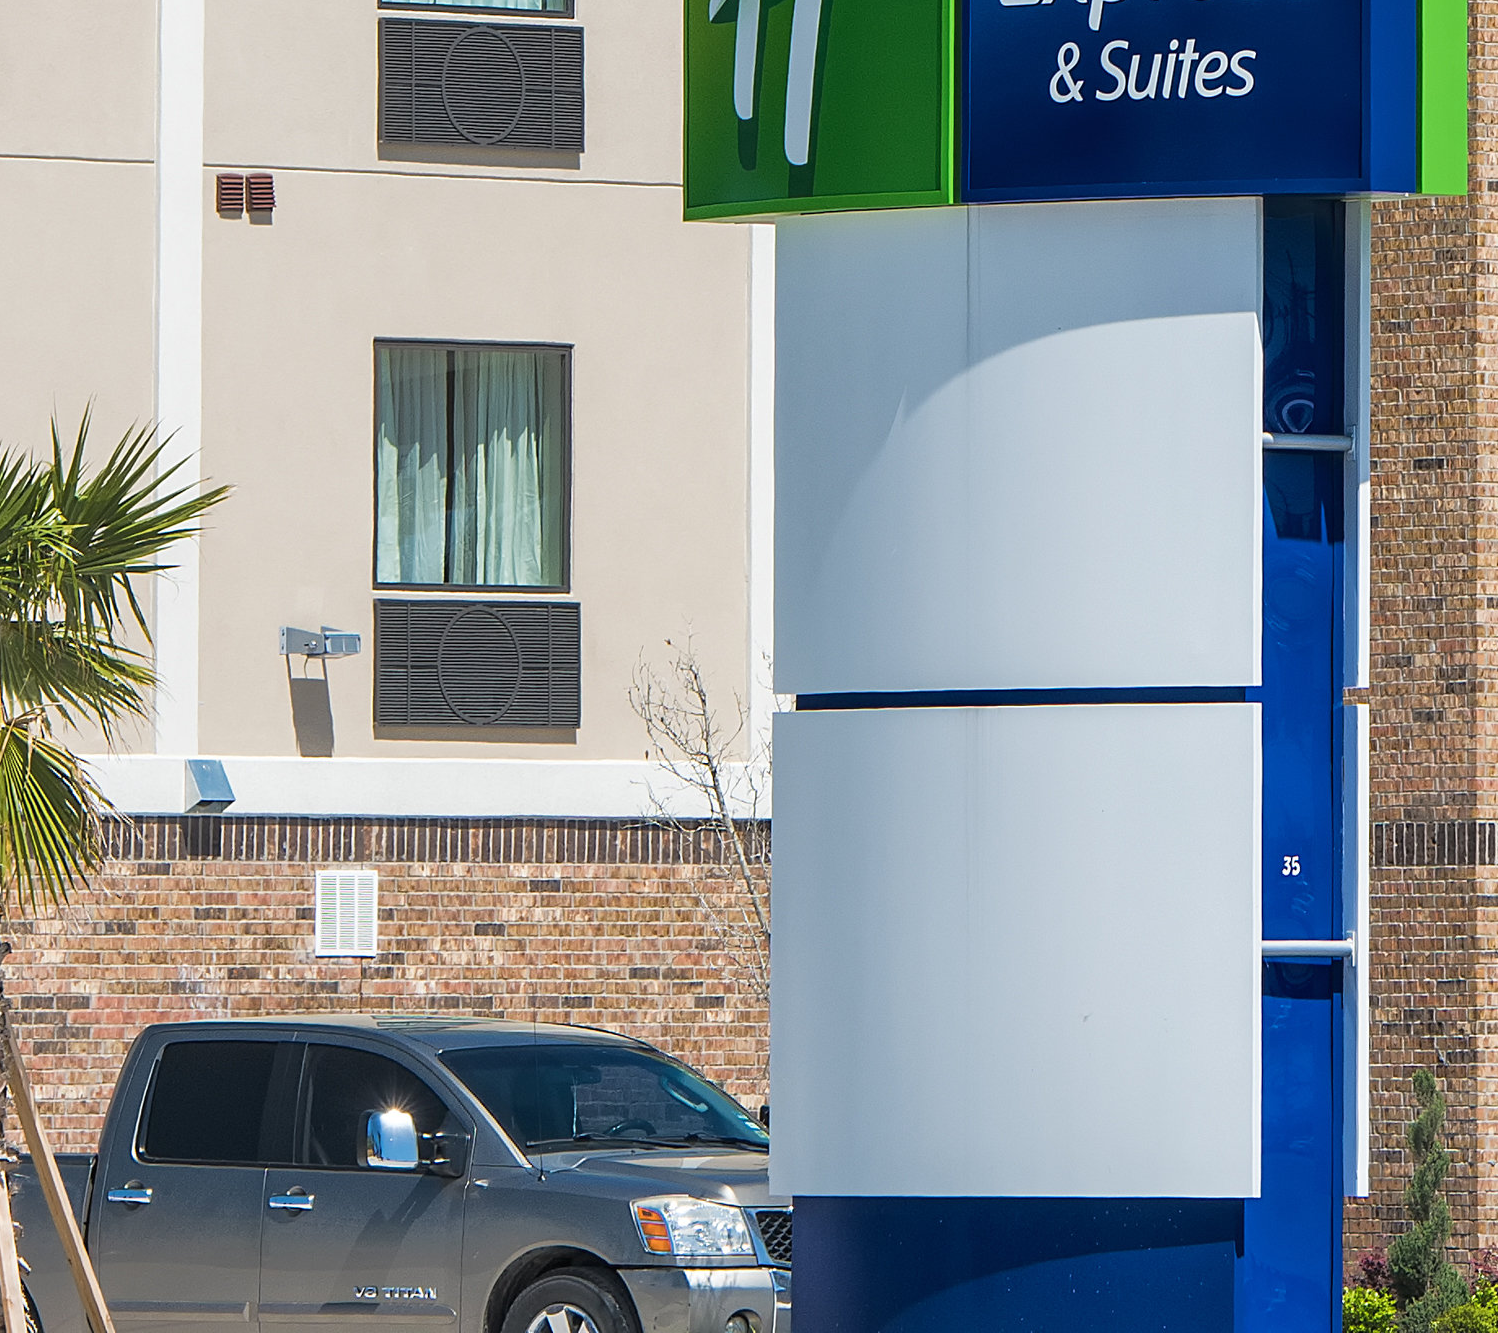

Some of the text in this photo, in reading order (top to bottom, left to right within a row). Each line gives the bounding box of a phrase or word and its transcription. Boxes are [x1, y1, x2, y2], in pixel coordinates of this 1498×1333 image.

[1048, 37, 1258, 105] & Suites
[1282, 855, 1301, 876] 35
[382, 1286, 438, 1300] TITAN
